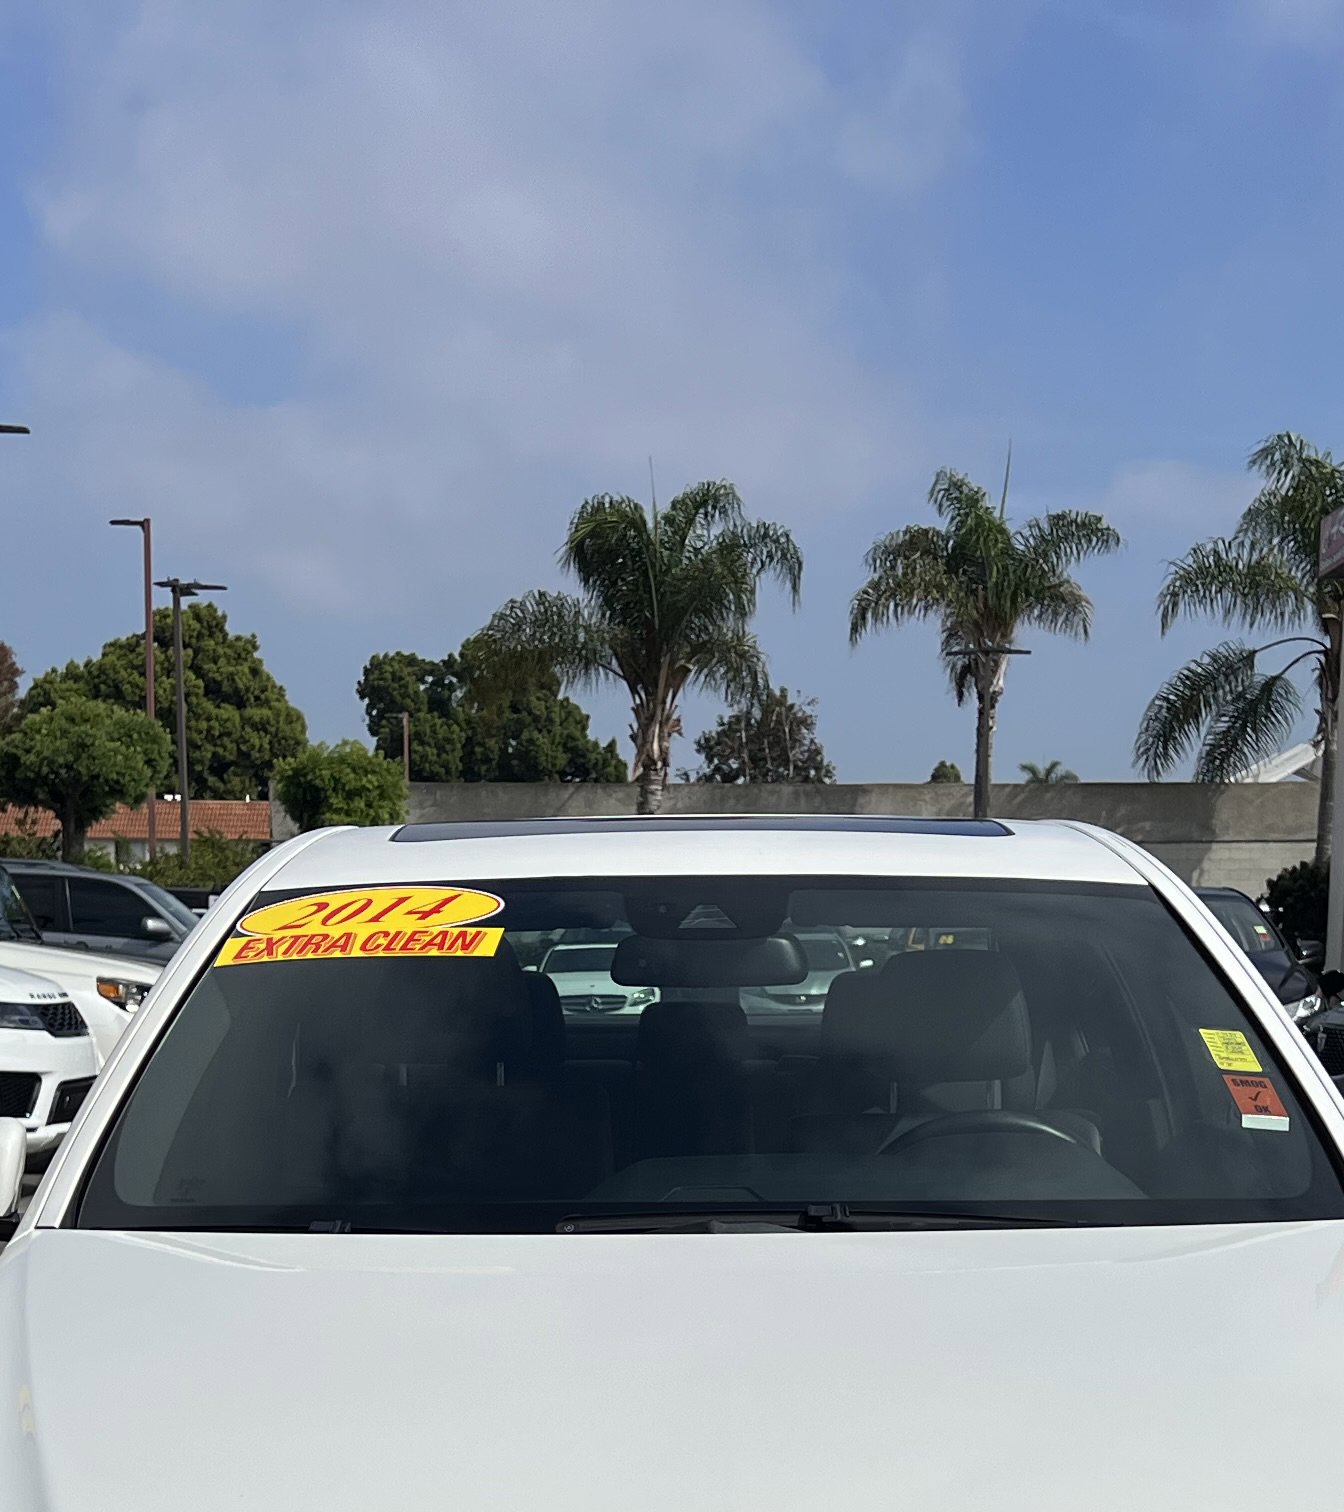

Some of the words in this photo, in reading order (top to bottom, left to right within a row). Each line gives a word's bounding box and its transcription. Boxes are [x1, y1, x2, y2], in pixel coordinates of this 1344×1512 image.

[271, 893, 463, 932] 2014
[232, 931, 354, 962] EXTRA
[359, 929, 488, 956] CLEAN
[1231, 1078, 1268, 1089] SMOG
[1254, 1105, 1272, 1114] OK
